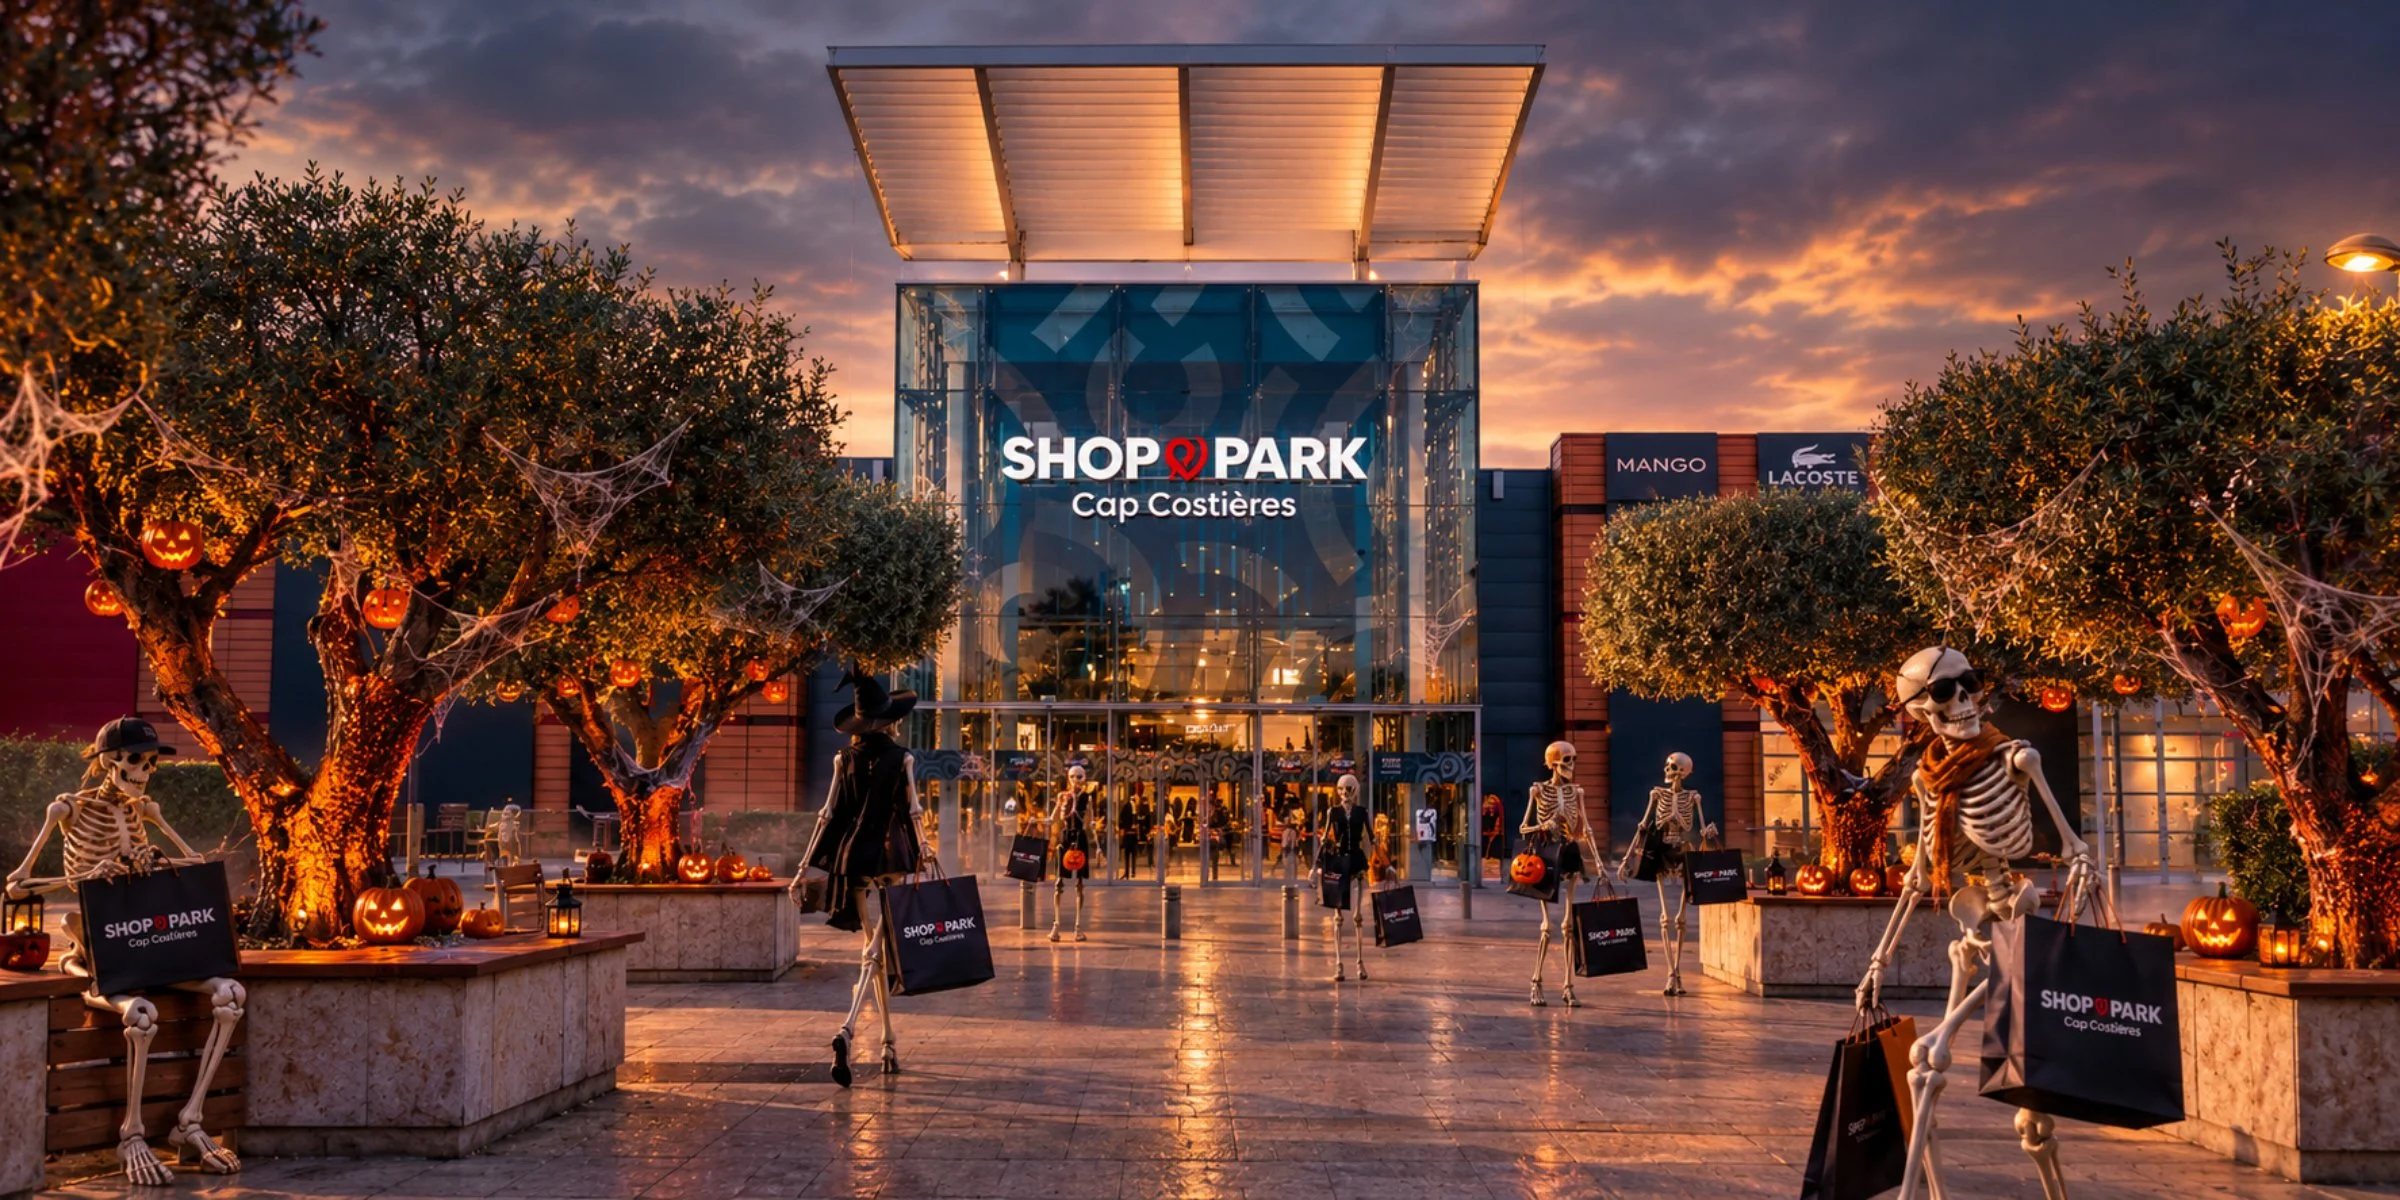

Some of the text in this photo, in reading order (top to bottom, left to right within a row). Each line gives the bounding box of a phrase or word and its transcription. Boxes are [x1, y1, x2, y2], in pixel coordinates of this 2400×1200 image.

[1001, 436, 1367, 480] SHOP PARK
[1617, 458, 1706, 472] MANGO
[1768, 470, 1858, 485] LACOSTE
[1072, 489, 1296, 522] Cap Costières
[104, 907, 215, 938] SHOP PARK
[904, 923, 935, 939] SHOP
[945, 916, 976, 932] PARK
[128, 938, 150, 947] Cap
[2041, 989, 2162, 1024] SHOP PARK
[2064, 1016, 2087, 1031] Cap
